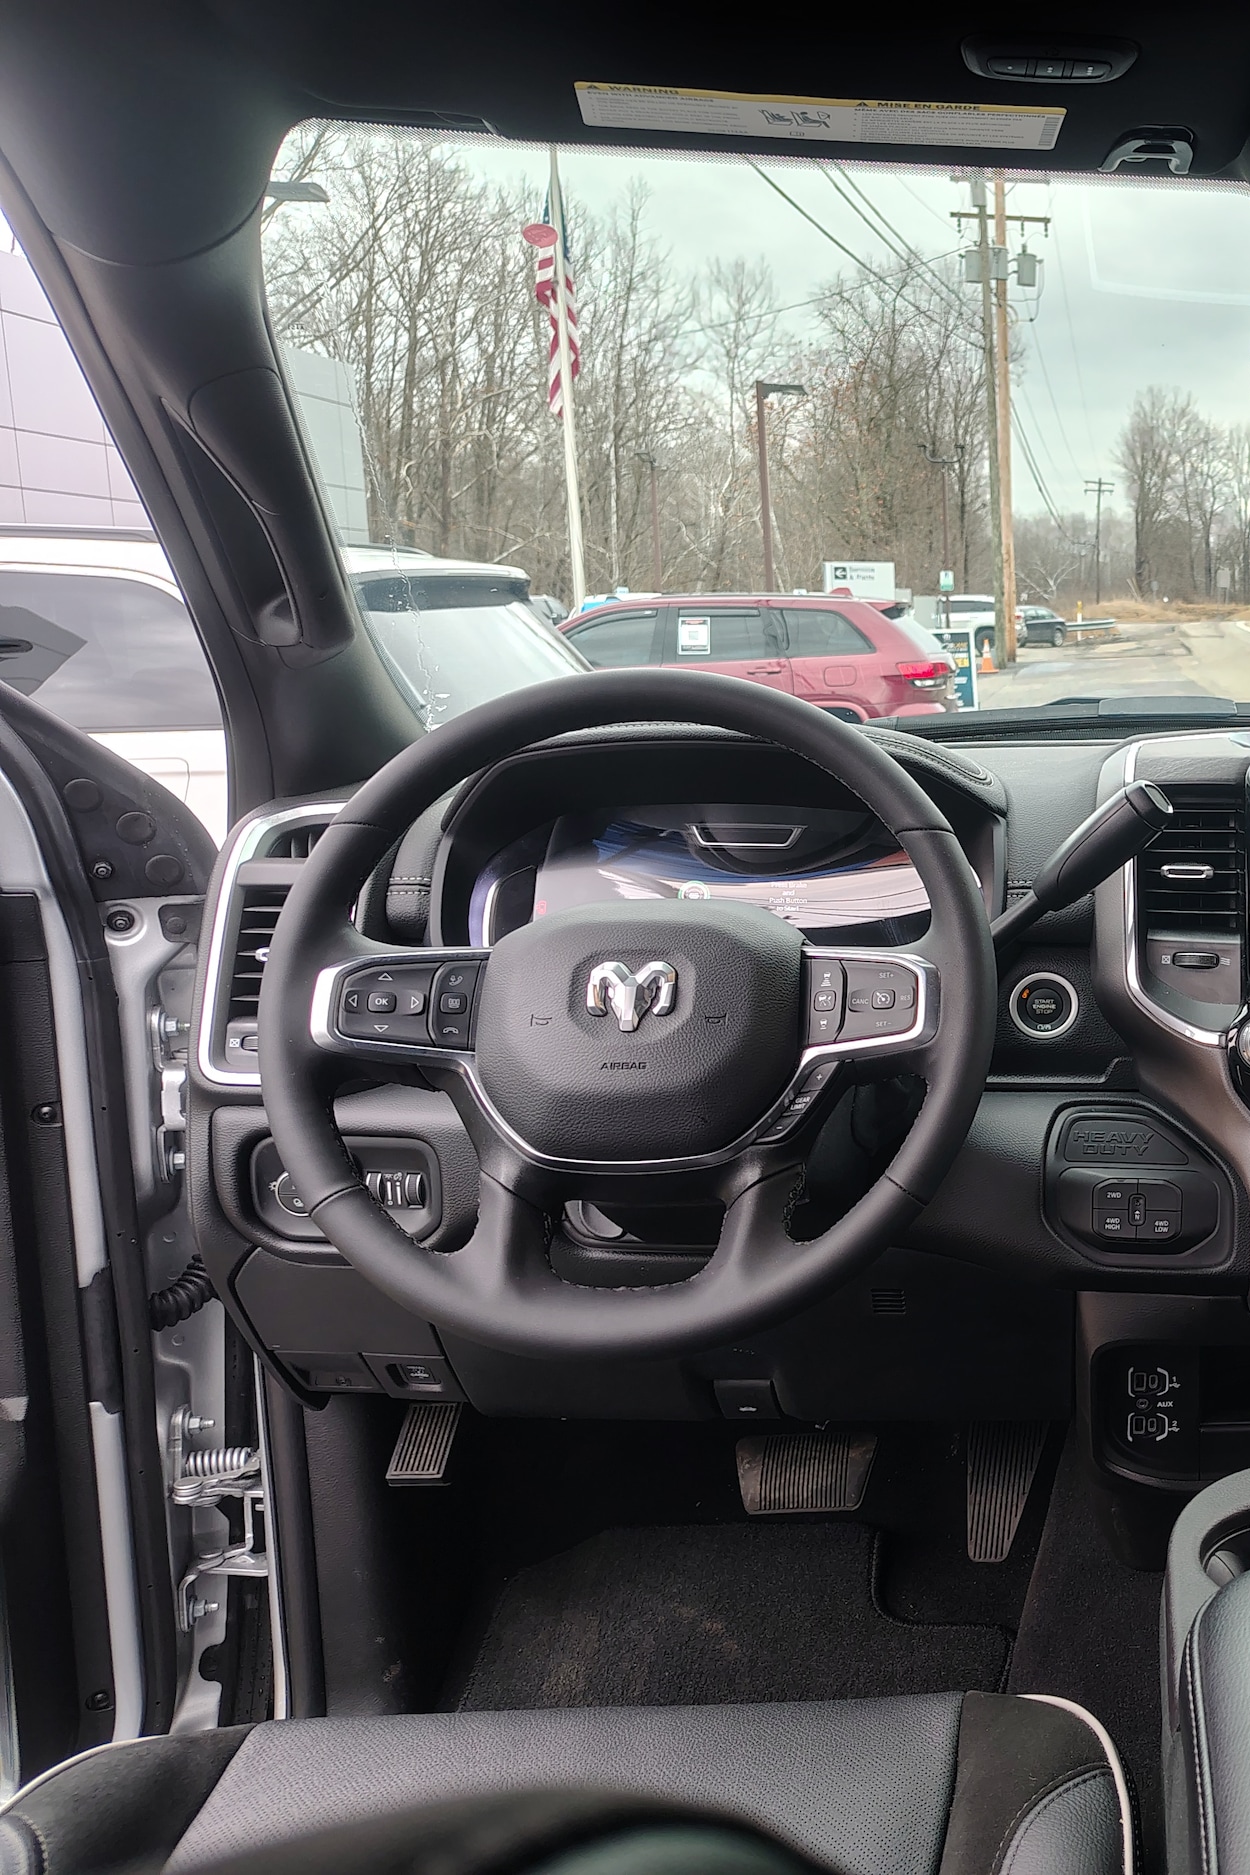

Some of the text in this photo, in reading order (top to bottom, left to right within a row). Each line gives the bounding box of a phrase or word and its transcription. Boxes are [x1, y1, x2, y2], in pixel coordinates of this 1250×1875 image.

[608, 85, 679, 95] WARNING
[877, 101, 911, 109] MISE
[375, 997, 389, 1006] OK
[600, 1061, 647, 1070] AIRBAG
[795, 1096, 811, 1104] GEAR
[1073, 1130, 1155, 1144] HEAVY
[1082, 1143, 1149, 1156] DUTY
[1106, 1191, 1122, 1199] 2WD
